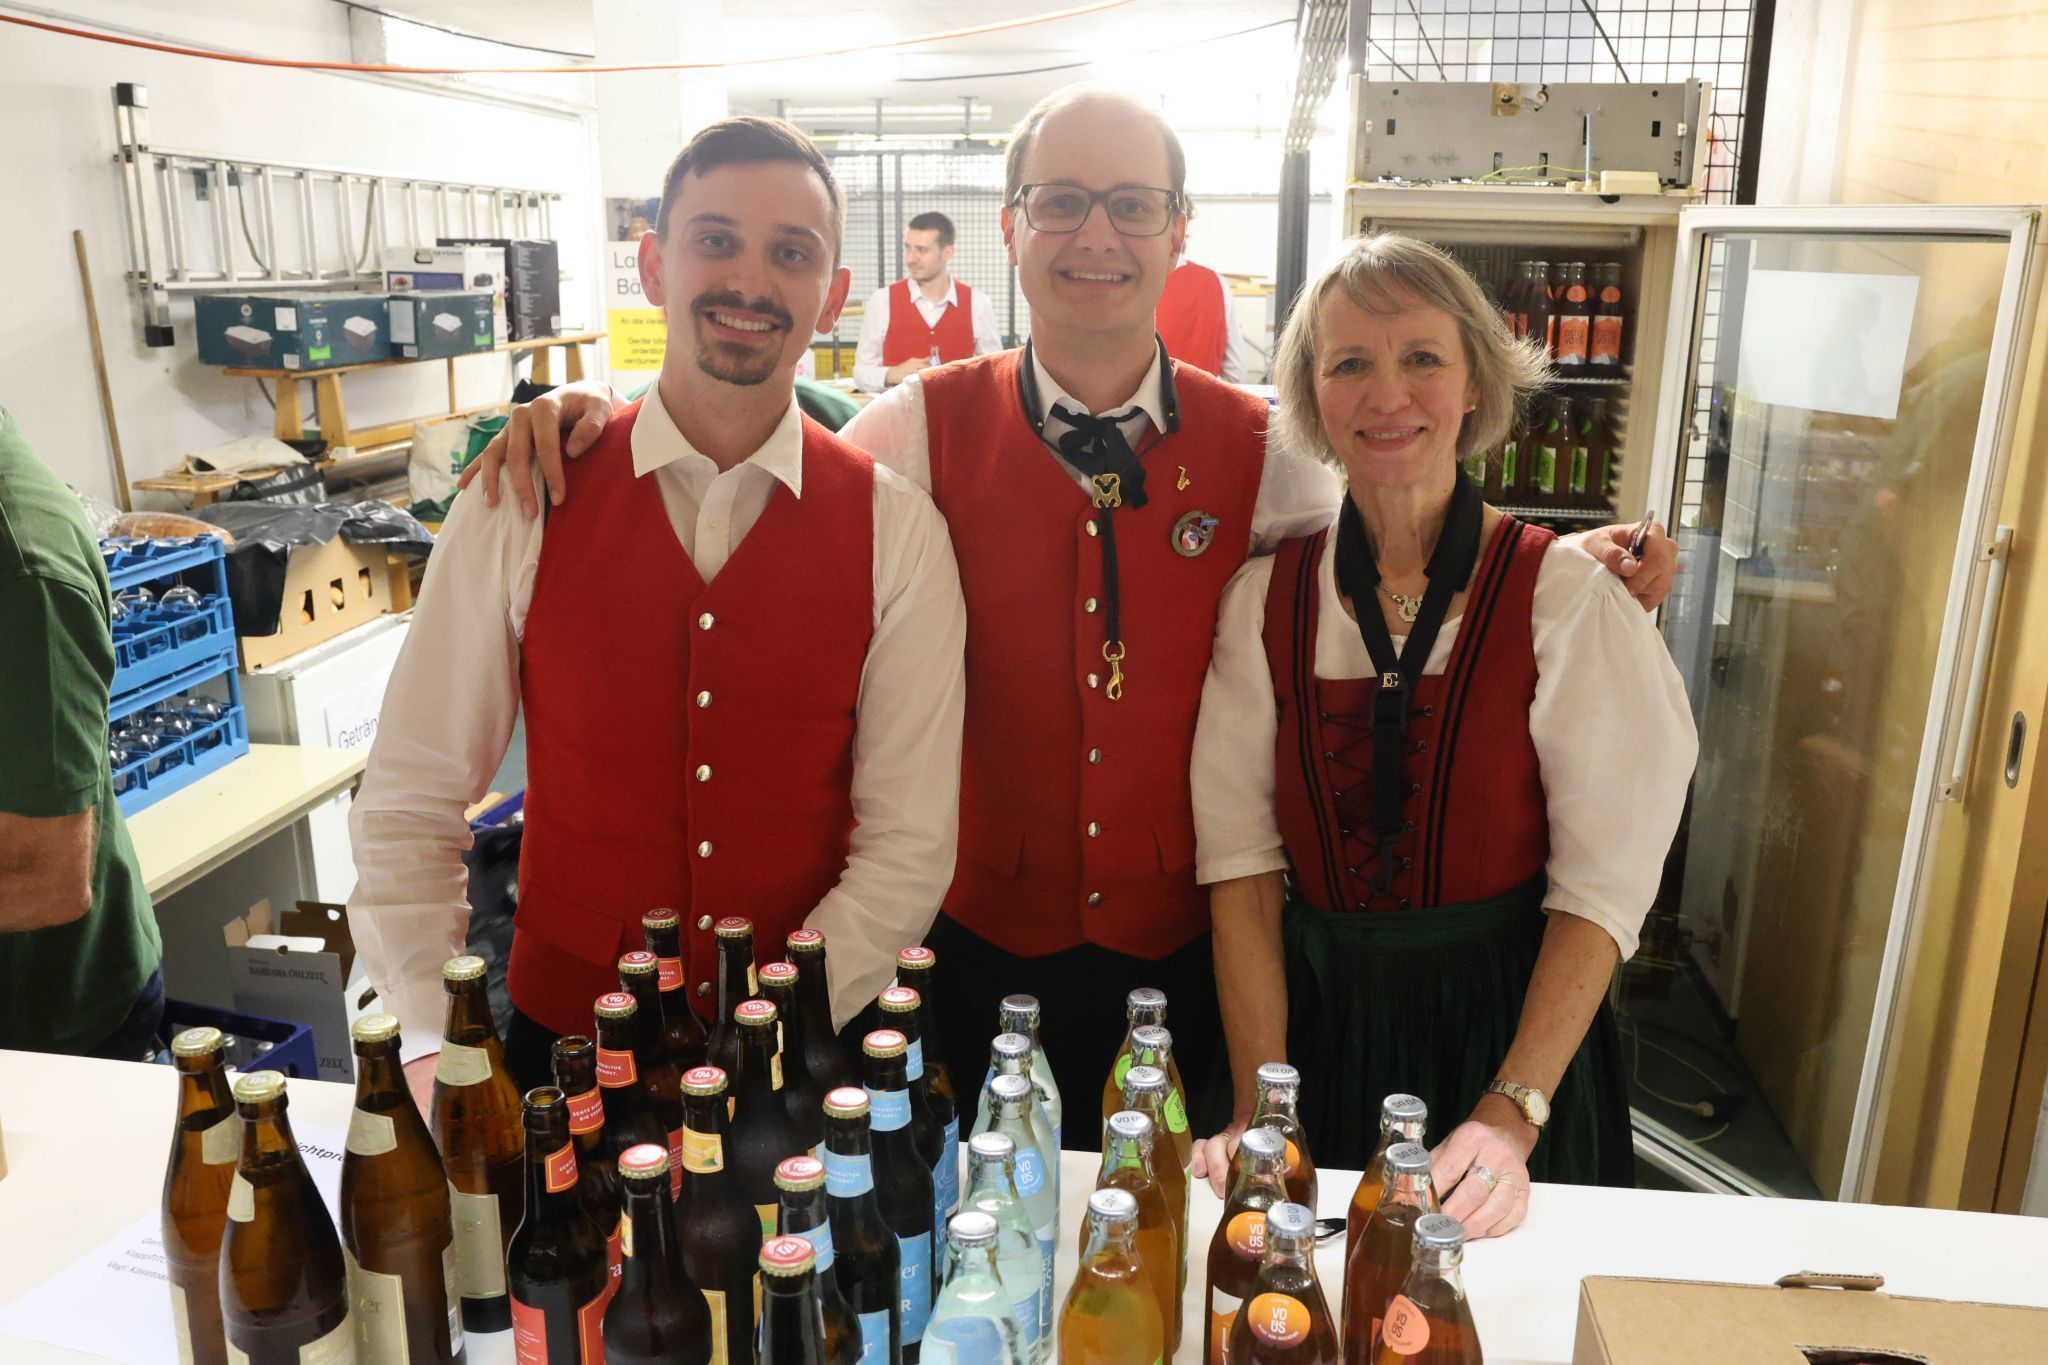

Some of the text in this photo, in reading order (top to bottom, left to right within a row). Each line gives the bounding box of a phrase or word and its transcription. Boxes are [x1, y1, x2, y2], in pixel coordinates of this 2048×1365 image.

[614, 252, 640, 269] La
[1018, 1160, 1031, 1172] VO
[1249, 1223, 1264, 1235] VO
[1272, 1306, 1288, 1321] VO
[1396, 1311, 1407, 1325] VO
